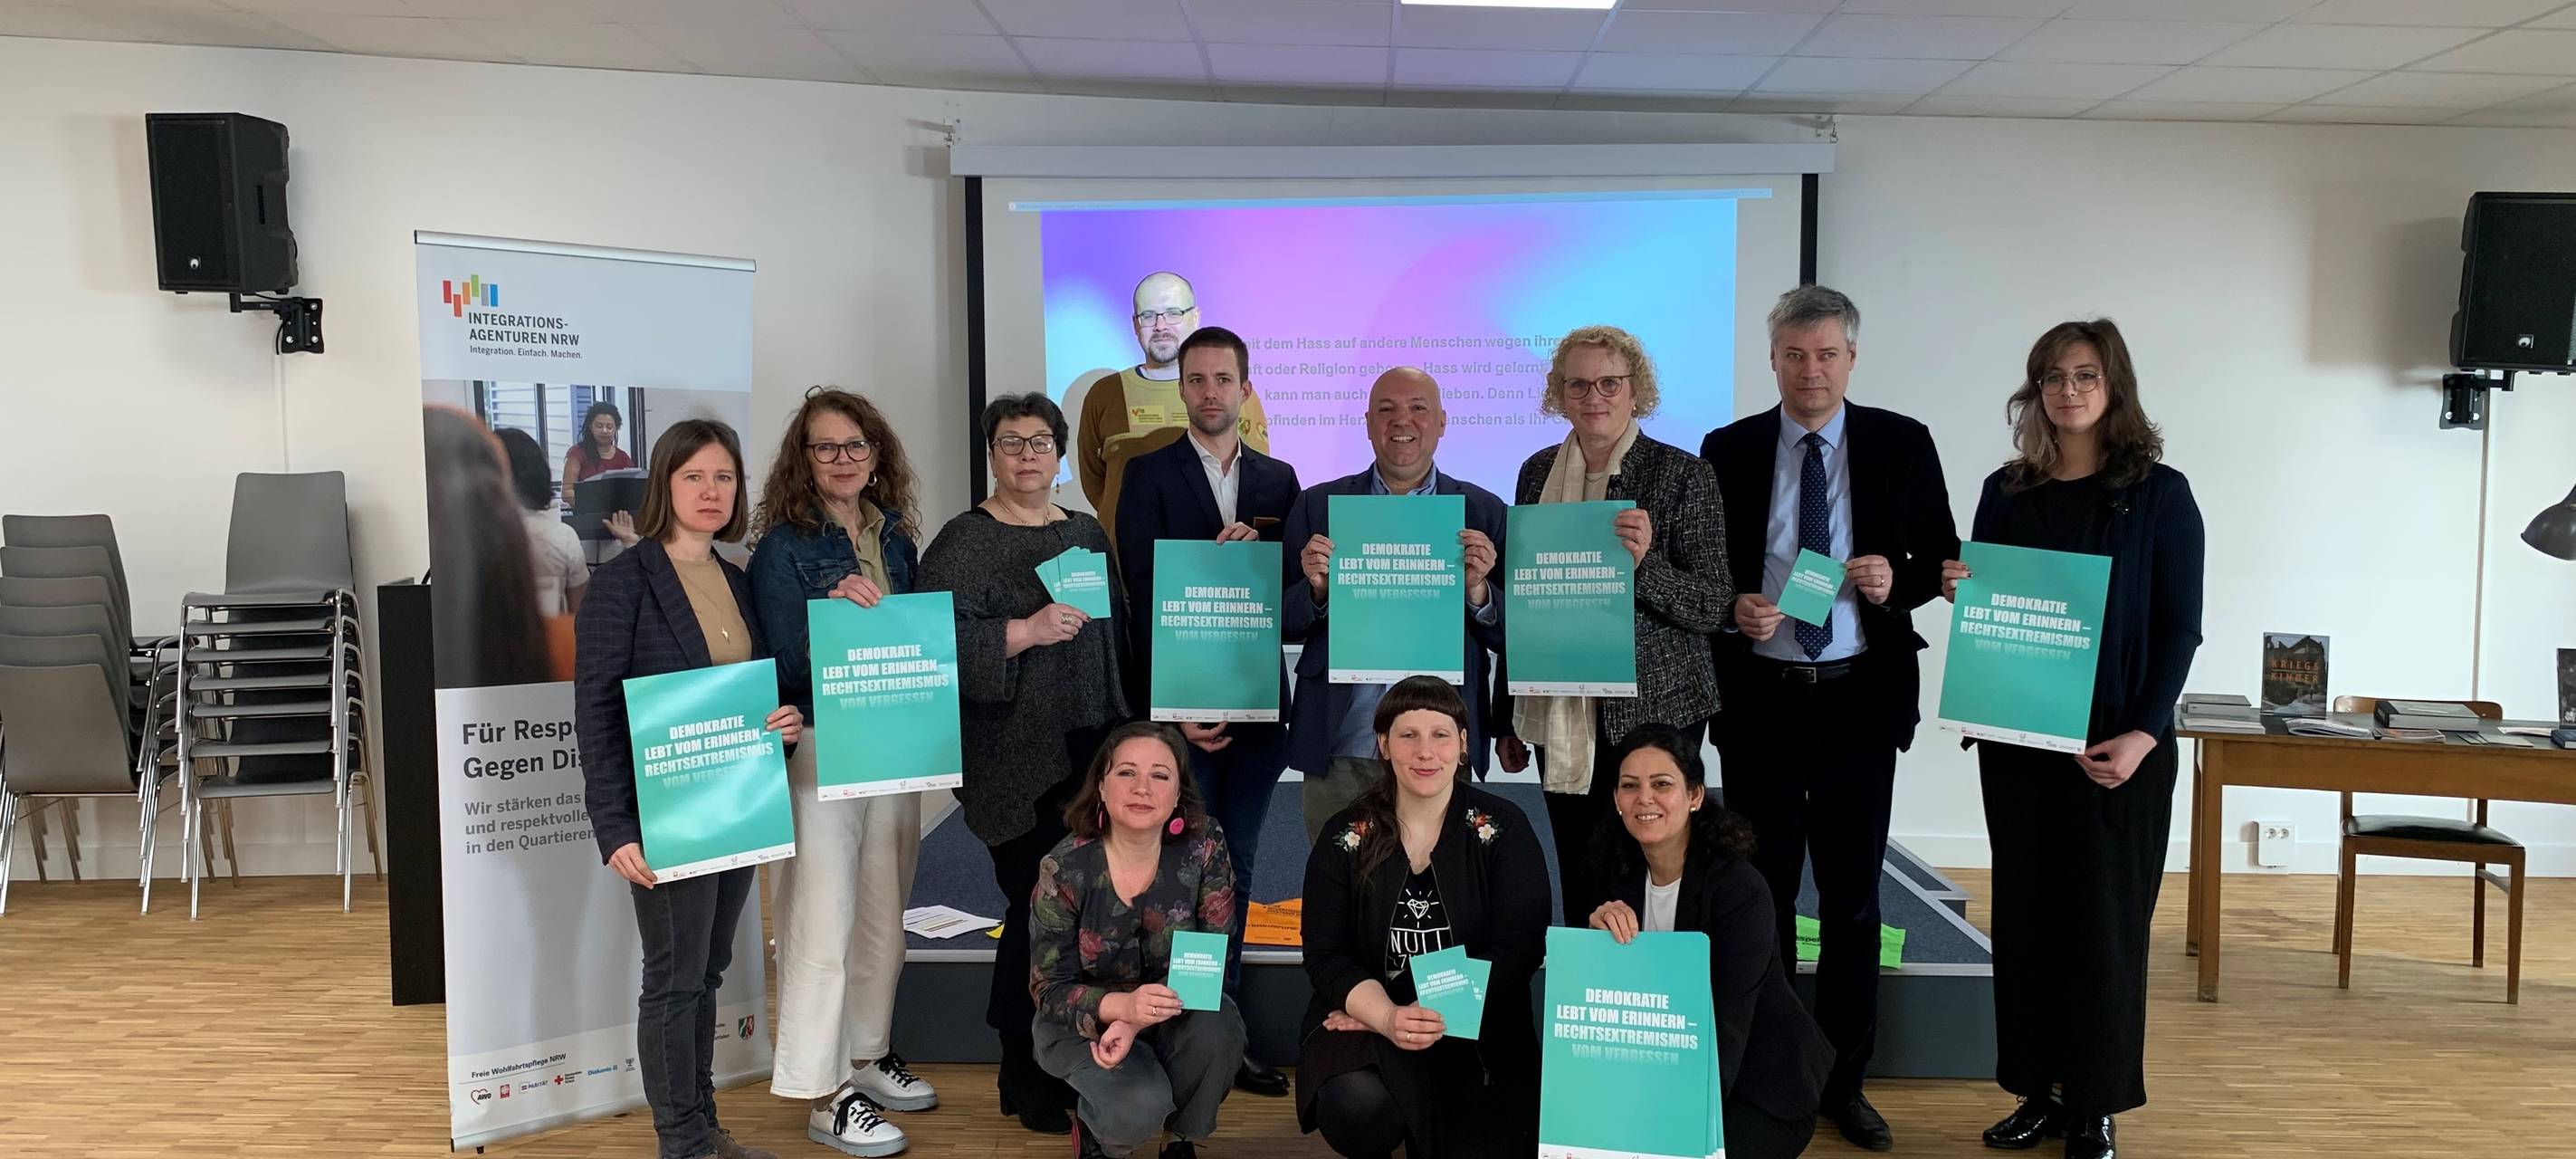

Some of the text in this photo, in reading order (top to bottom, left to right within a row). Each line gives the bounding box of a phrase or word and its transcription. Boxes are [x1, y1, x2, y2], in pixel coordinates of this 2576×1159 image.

[469, 312, 568, 329] INTEGRATIONS-
[469, 329, 579, 346] AGENTUREN NRW
[1264, 338, 1293, 350] dem
[1297, 338, 1331, 350] Hass
[1335, 337, 1357, 349] auf
[1360, 337, 1407, 349] andere
[1410, 336, 1482, 349] Menschen
[1484, 337, 1531, 350] wegen
[470, 345, 583, 359] Integration. Einfach. Machen.
[1264, 364, 1296, 375] oder
[1300, 363, 1355, 377] Religion
[1423, 361, 1457, 374] Hass
[1461, 361, 1491, 373] wird
[1264, 389, 1298, 400] kann
[1302, 391, 1331, 400] man
[1334, 388, 1368, 400] auch
[1487, 387, 1524, 399] Denn
[1319, 414, 1335, 426] im
[1445, 413, 1502, 426] nschen
[1504, 413, 1524, 425] als
[1362, 543, 1431, 555] DEMOKRATIE
[1339, 558, 1364, 570] LEBT
[1366, 558, 1390, 570] VOM
[1392, 559, 1445, 570] ERINNERN
[1536, 551, 1602, 565] DEMOKRATIE
[1338, 573, 1455, 586] RECHTSEXTREMISMUS
[1514, 569, 1538, 580] LEBT
[1540, 568, 1562, 580] VOM
[1565, 566, 1615, 580] ERINNERN
[1185, 587, 1250, 599] DEMOKRATIE
[1512, 582, 1626, 596] RECHTSEXTREMISMUS
[1162, 600, 1187, 612] LEBT
[1188, 601, 1211, 613] VOM
[1213, 601, 1263, 614] ERINNERN
[1991, 593, 2067, 615] DEMOKRATIE
[1160, 615, 1273, 628] RECHTSEXTREMISMUS
[1963, 606, 1991, 620] LEBT
[1993, 608, 2020, 625] VOM
[2022, 613, 2081, 632] ERINNERN
[1960, 620, 2091, 649] RECHTSEXTREMISMUS
[847, 644, 922, 662] DEMOKRATIE
[823, 666, 850, 680] LEBT
[852, 664, 879, 677] VOM
[882, 659, 937, 675] ERINNERN
[822, 674, 949, 695] RECHTSEXTREMISMUS
[463, 719, 573, 744] Für Resp
[669, 715, 744, 740] DEMOKRATIE
[644, 744, 673, 761] LEBT
[674, 740, 701, 755] VOM
[704, 728, 760, 750] ERINNERN
[463, 749, 582, 781] Gegen Di
[644, 742, 774, 777] RECHTSEXTREMISMUS
[464, 792, 581, 815] Wir stärken das
[465, 820, 495, 835] und
[466, 841, 481, 854] in
[486, 838, 514, 853] den
[1586, 988, 1669, 1010] DEMOKRATIE
[1556, 1004, 1587, 1020] LEBT
[1589, 1007, 1619, 1024] VOM
[1622, 1011, 1685, 1030] ERINNERN
[1554, 1022, 1699, 1049] RECHTSEXTREMISMUS
[472, 1053, 566, 1078] Freie Wohlfahrtspflege NRW
